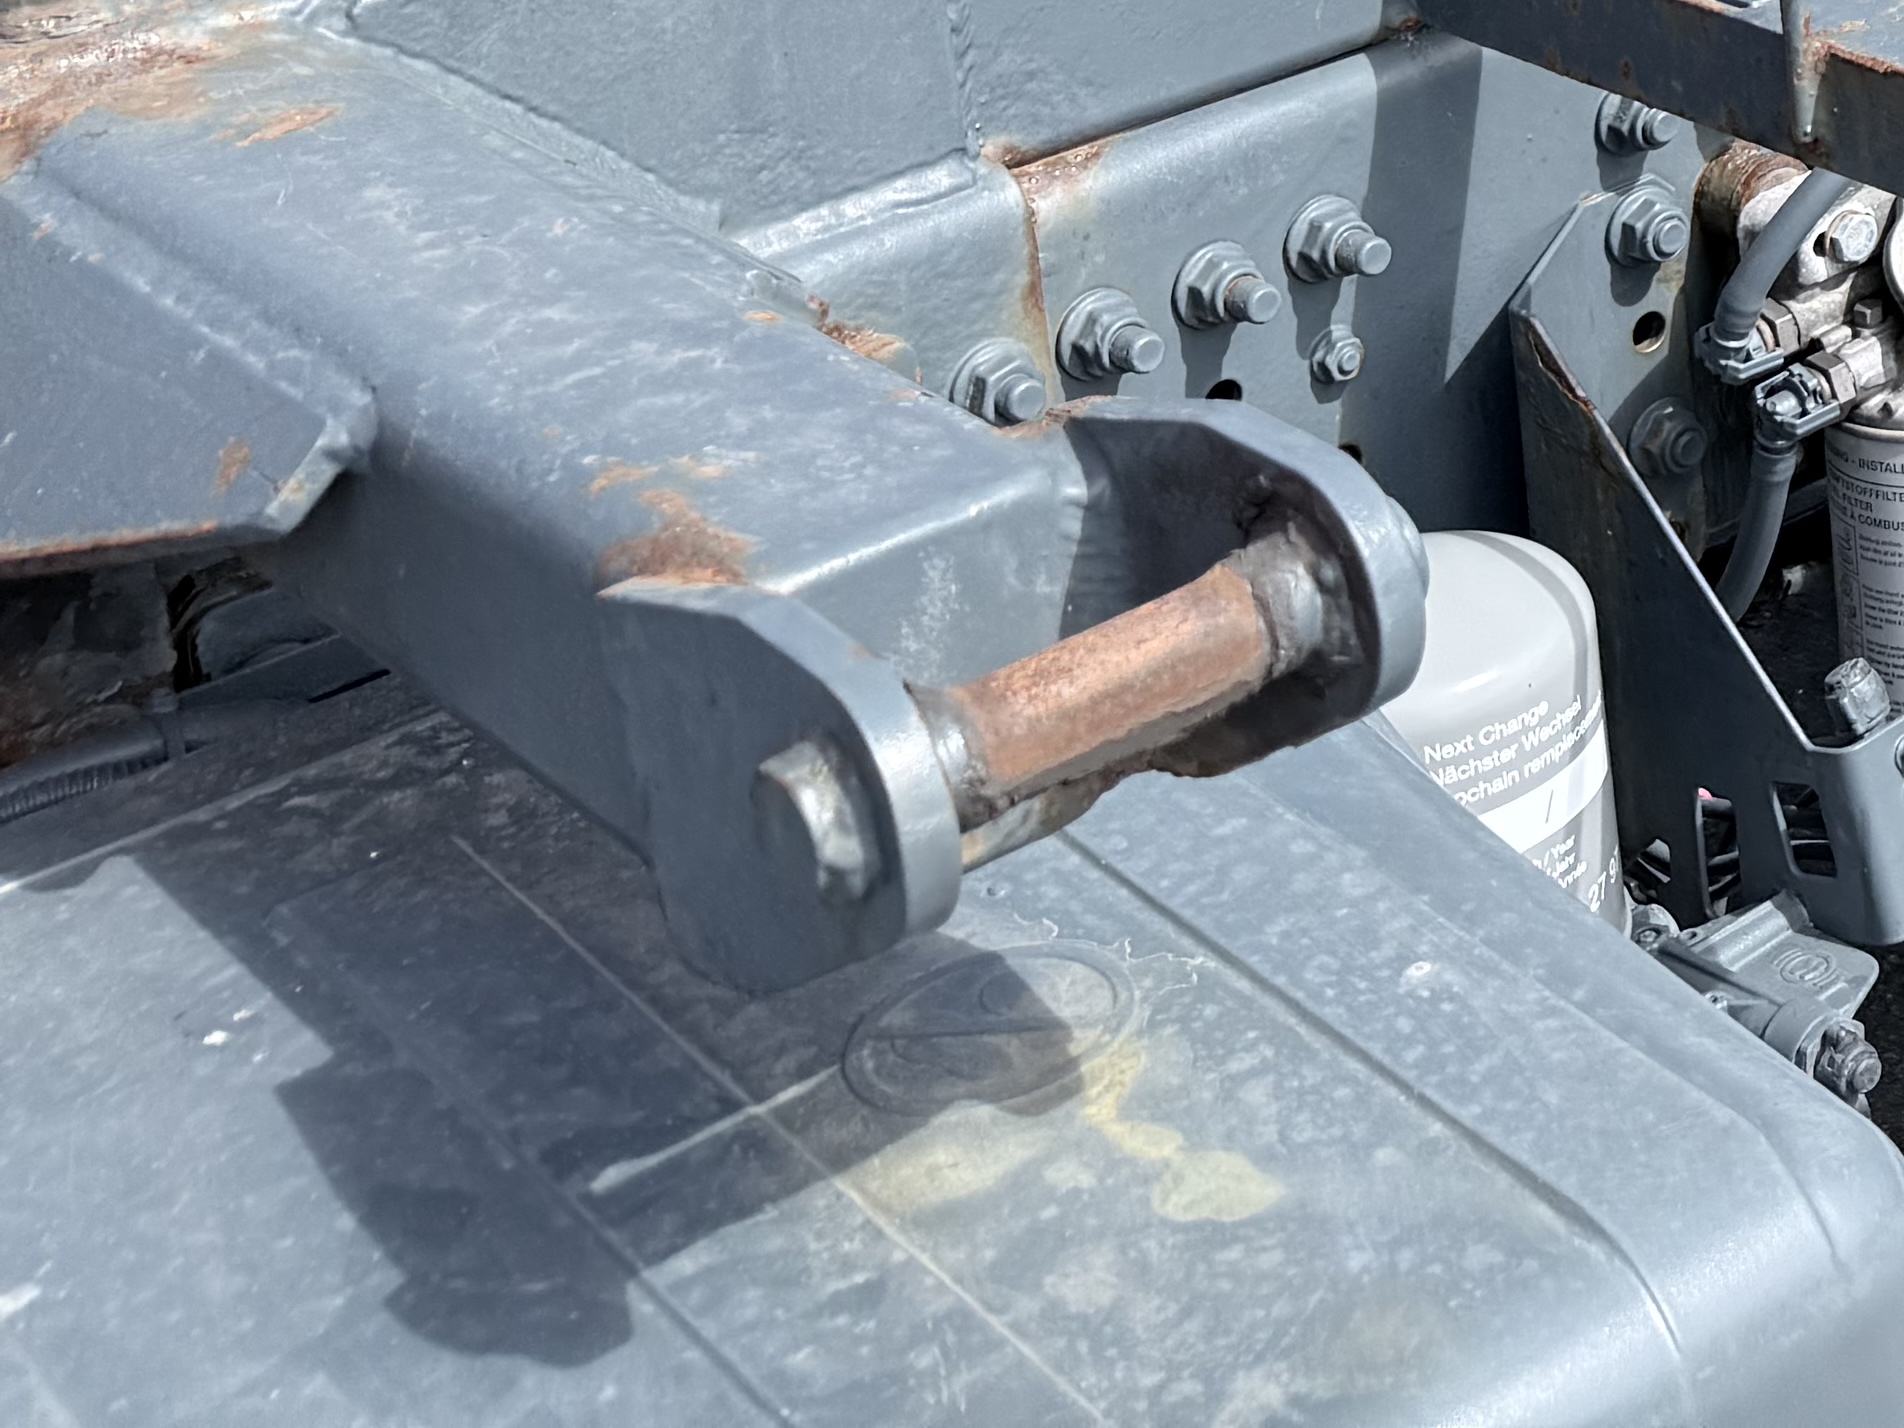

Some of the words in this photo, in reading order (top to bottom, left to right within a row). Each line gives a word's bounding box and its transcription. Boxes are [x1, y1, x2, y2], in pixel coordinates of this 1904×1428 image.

[1842, 493, 1873, 513] FILTER
[1423, 734, 1476, 765] Next
[1478, 700, 1550, 746] Change
[1429, 743, 1519, 786] Nächster
[1521, 694, 1582, 752] Wechsel
